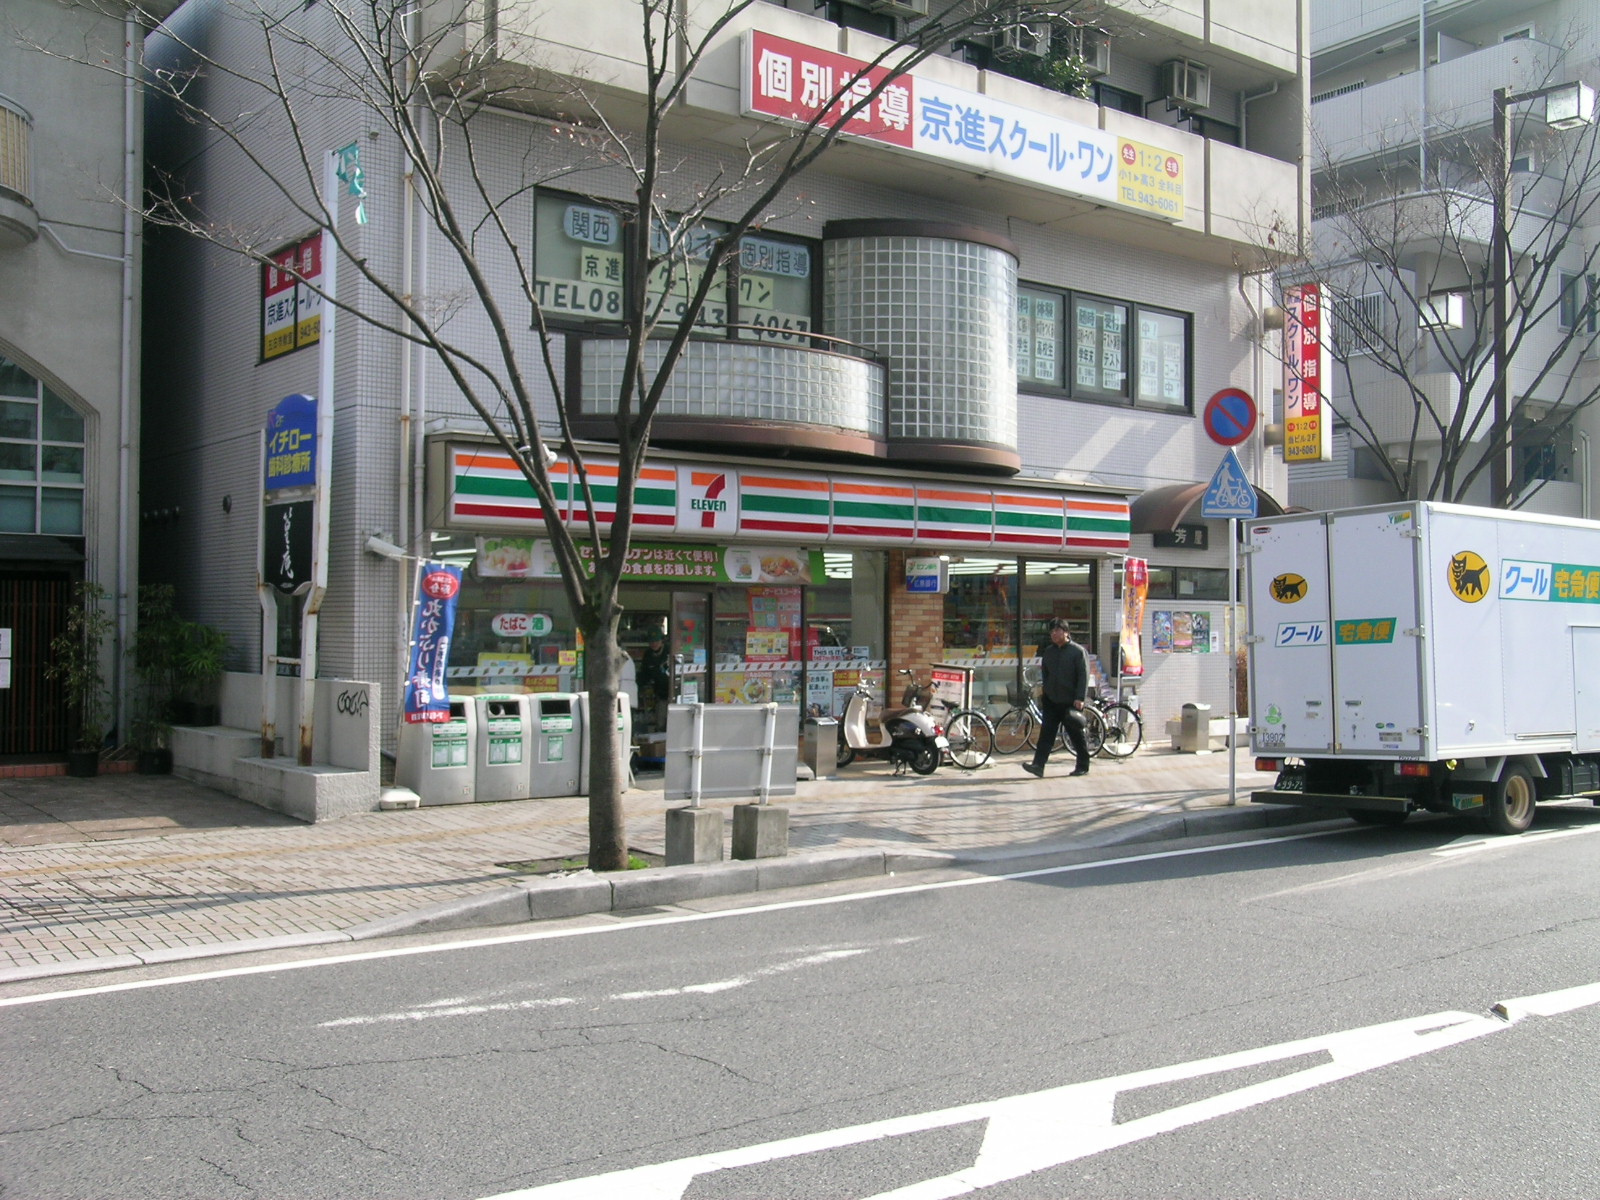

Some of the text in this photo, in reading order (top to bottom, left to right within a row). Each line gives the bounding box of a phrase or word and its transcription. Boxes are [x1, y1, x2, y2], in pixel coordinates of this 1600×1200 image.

[757, 47, 911, 133] 個別指導
[918, 96, 1115, 183] 京進スクール・ワン
[1121, 186, 1137, 202] TEL
[571, 209, 610, 243] 関西
[741, 241, 808, 278] 個別指導
[1103, 352, 1120, 369] テスト
[269, 428, 313, 454] イチロー
[1505, 565, 1600, 599] クール 宅急便
[499, 617, 527, 631] たばこ
[1281, 621, 1391, 644] クール 宅急便
